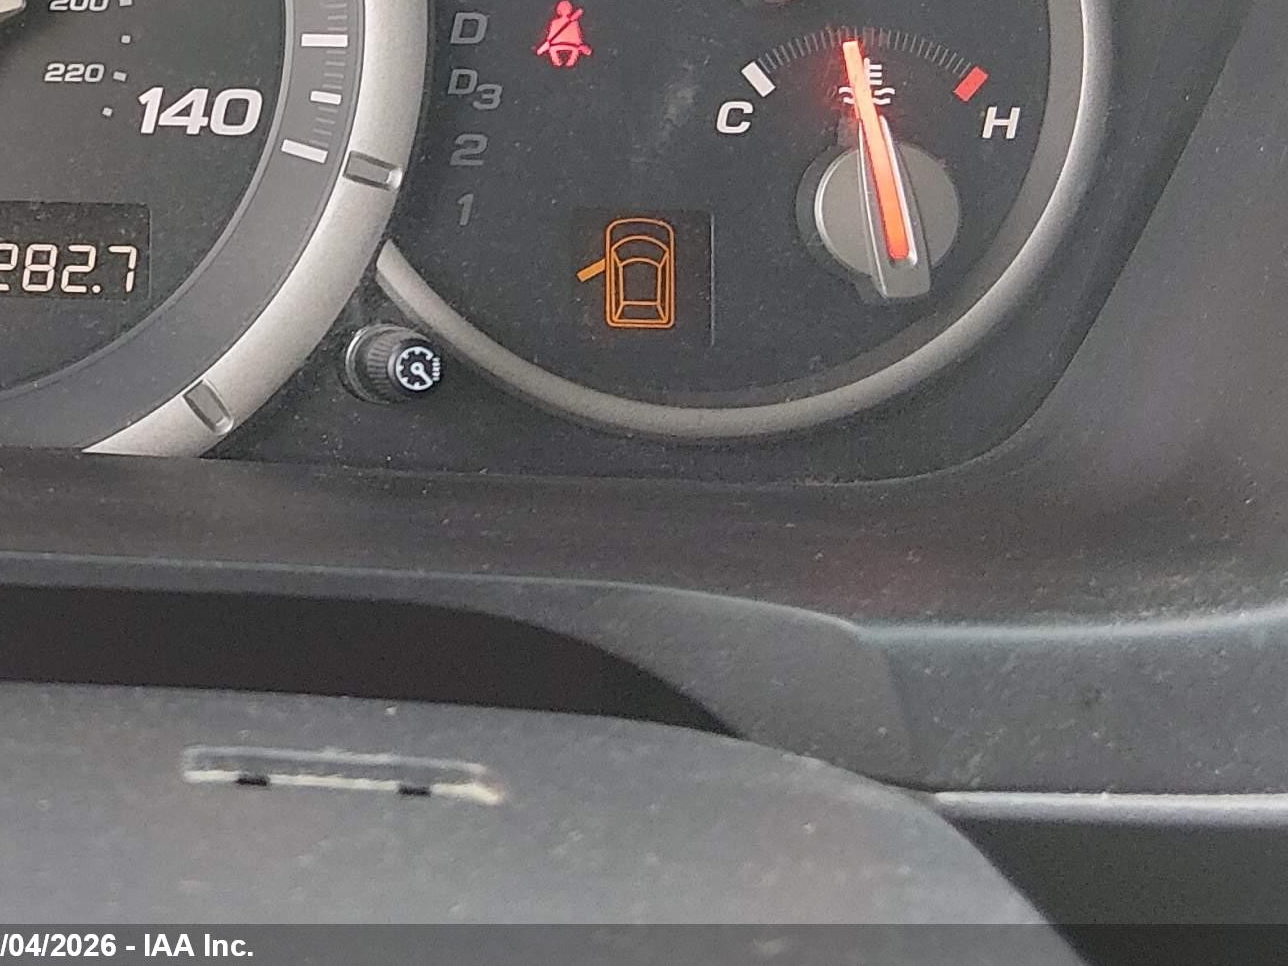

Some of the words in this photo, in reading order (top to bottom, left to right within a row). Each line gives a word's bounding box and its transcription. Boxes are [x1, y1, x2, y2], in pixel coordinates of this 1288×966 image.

[450, 11, 491, 44] D
[44, 62, 105, 83] 220
[138, 87, 263, 136] 140
[716, 101, 754, 134] C
[982, 105, 1021, 139] H
[450, 133, 489, 166] 2
[457, 193, 474, 226] 1
